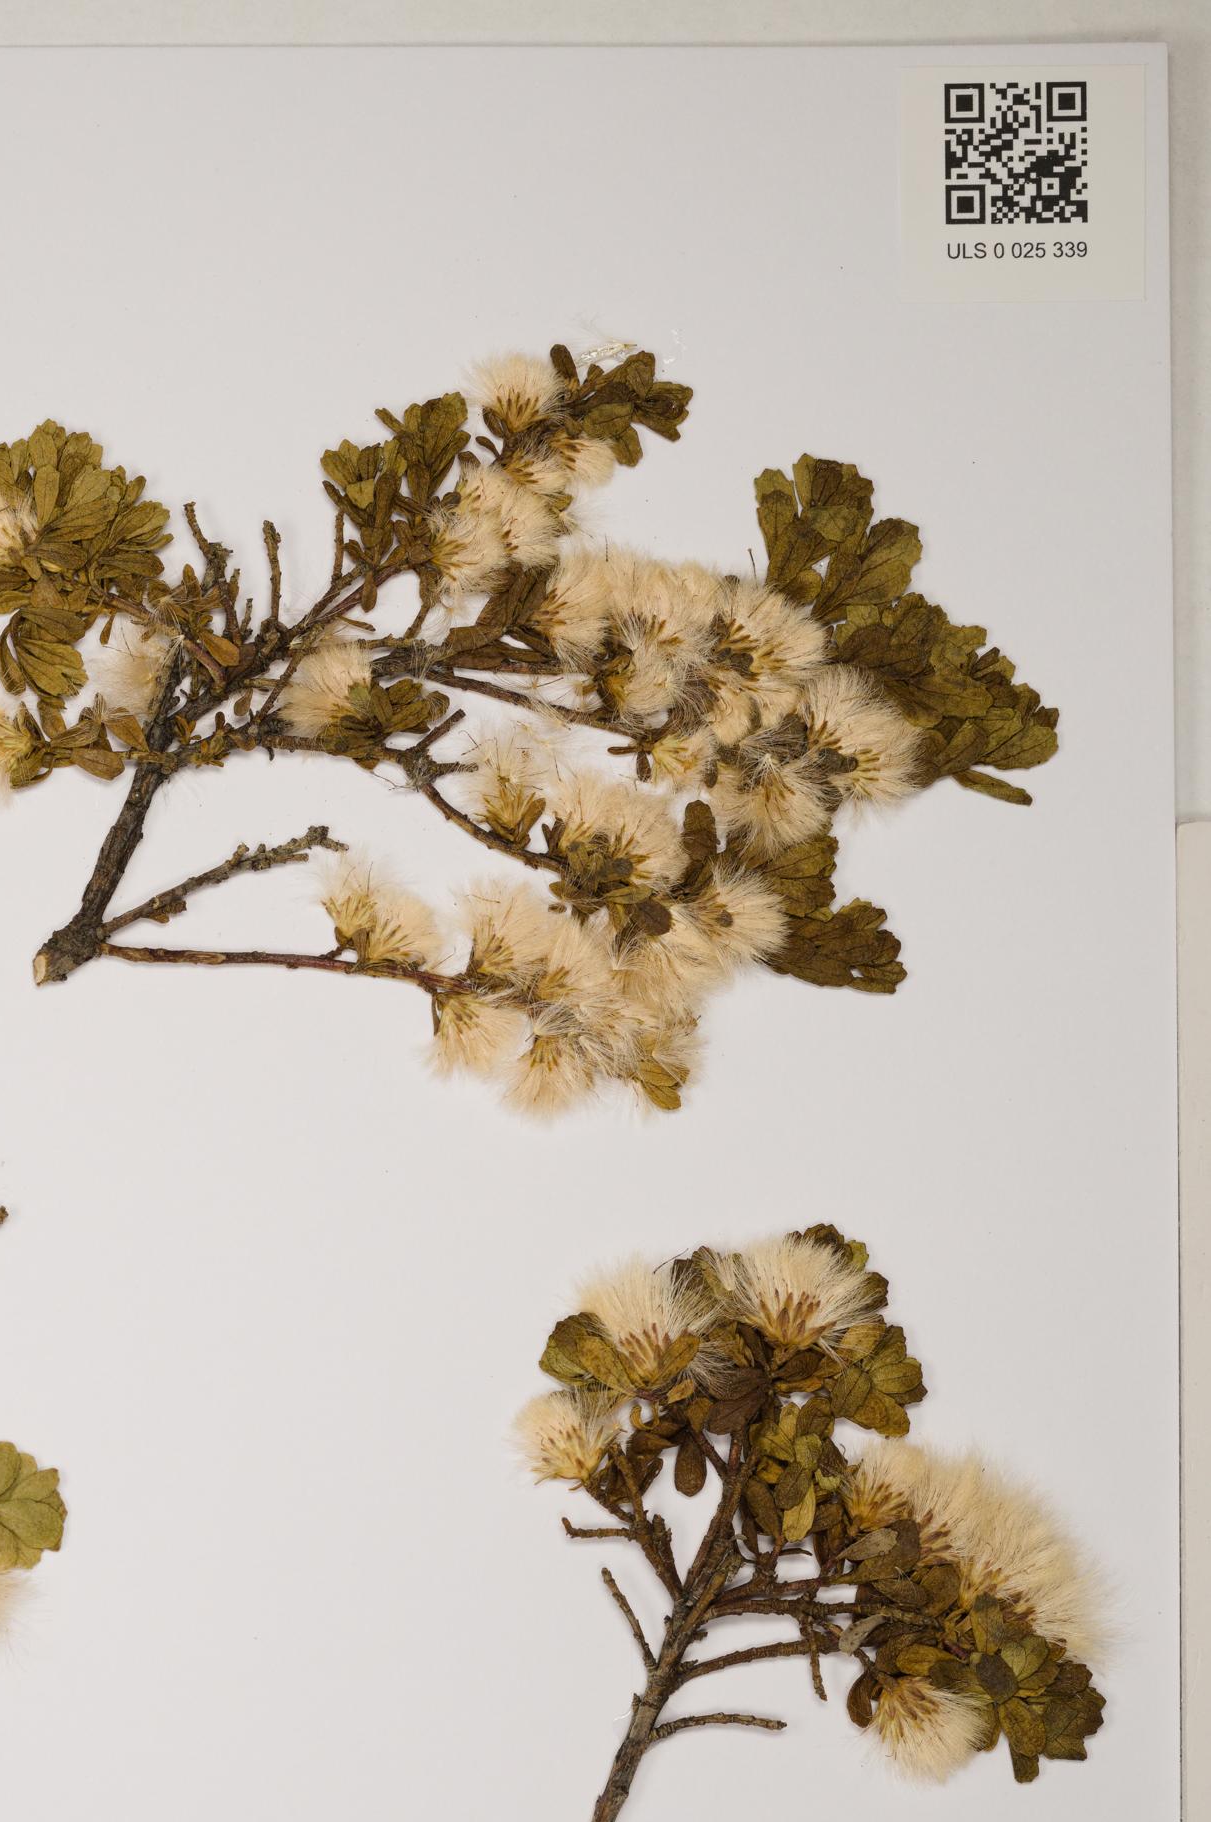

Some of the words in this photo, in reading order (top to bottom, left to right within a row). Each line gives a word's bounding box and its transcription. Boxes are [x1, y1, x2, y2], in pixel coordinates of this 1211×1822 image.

[947, 242, 987, 260] ULS
[993, 242, 1005, 259] 0
[1011, 242, 1046, 259] 025
[1053, 241, 1088, 258] 339
